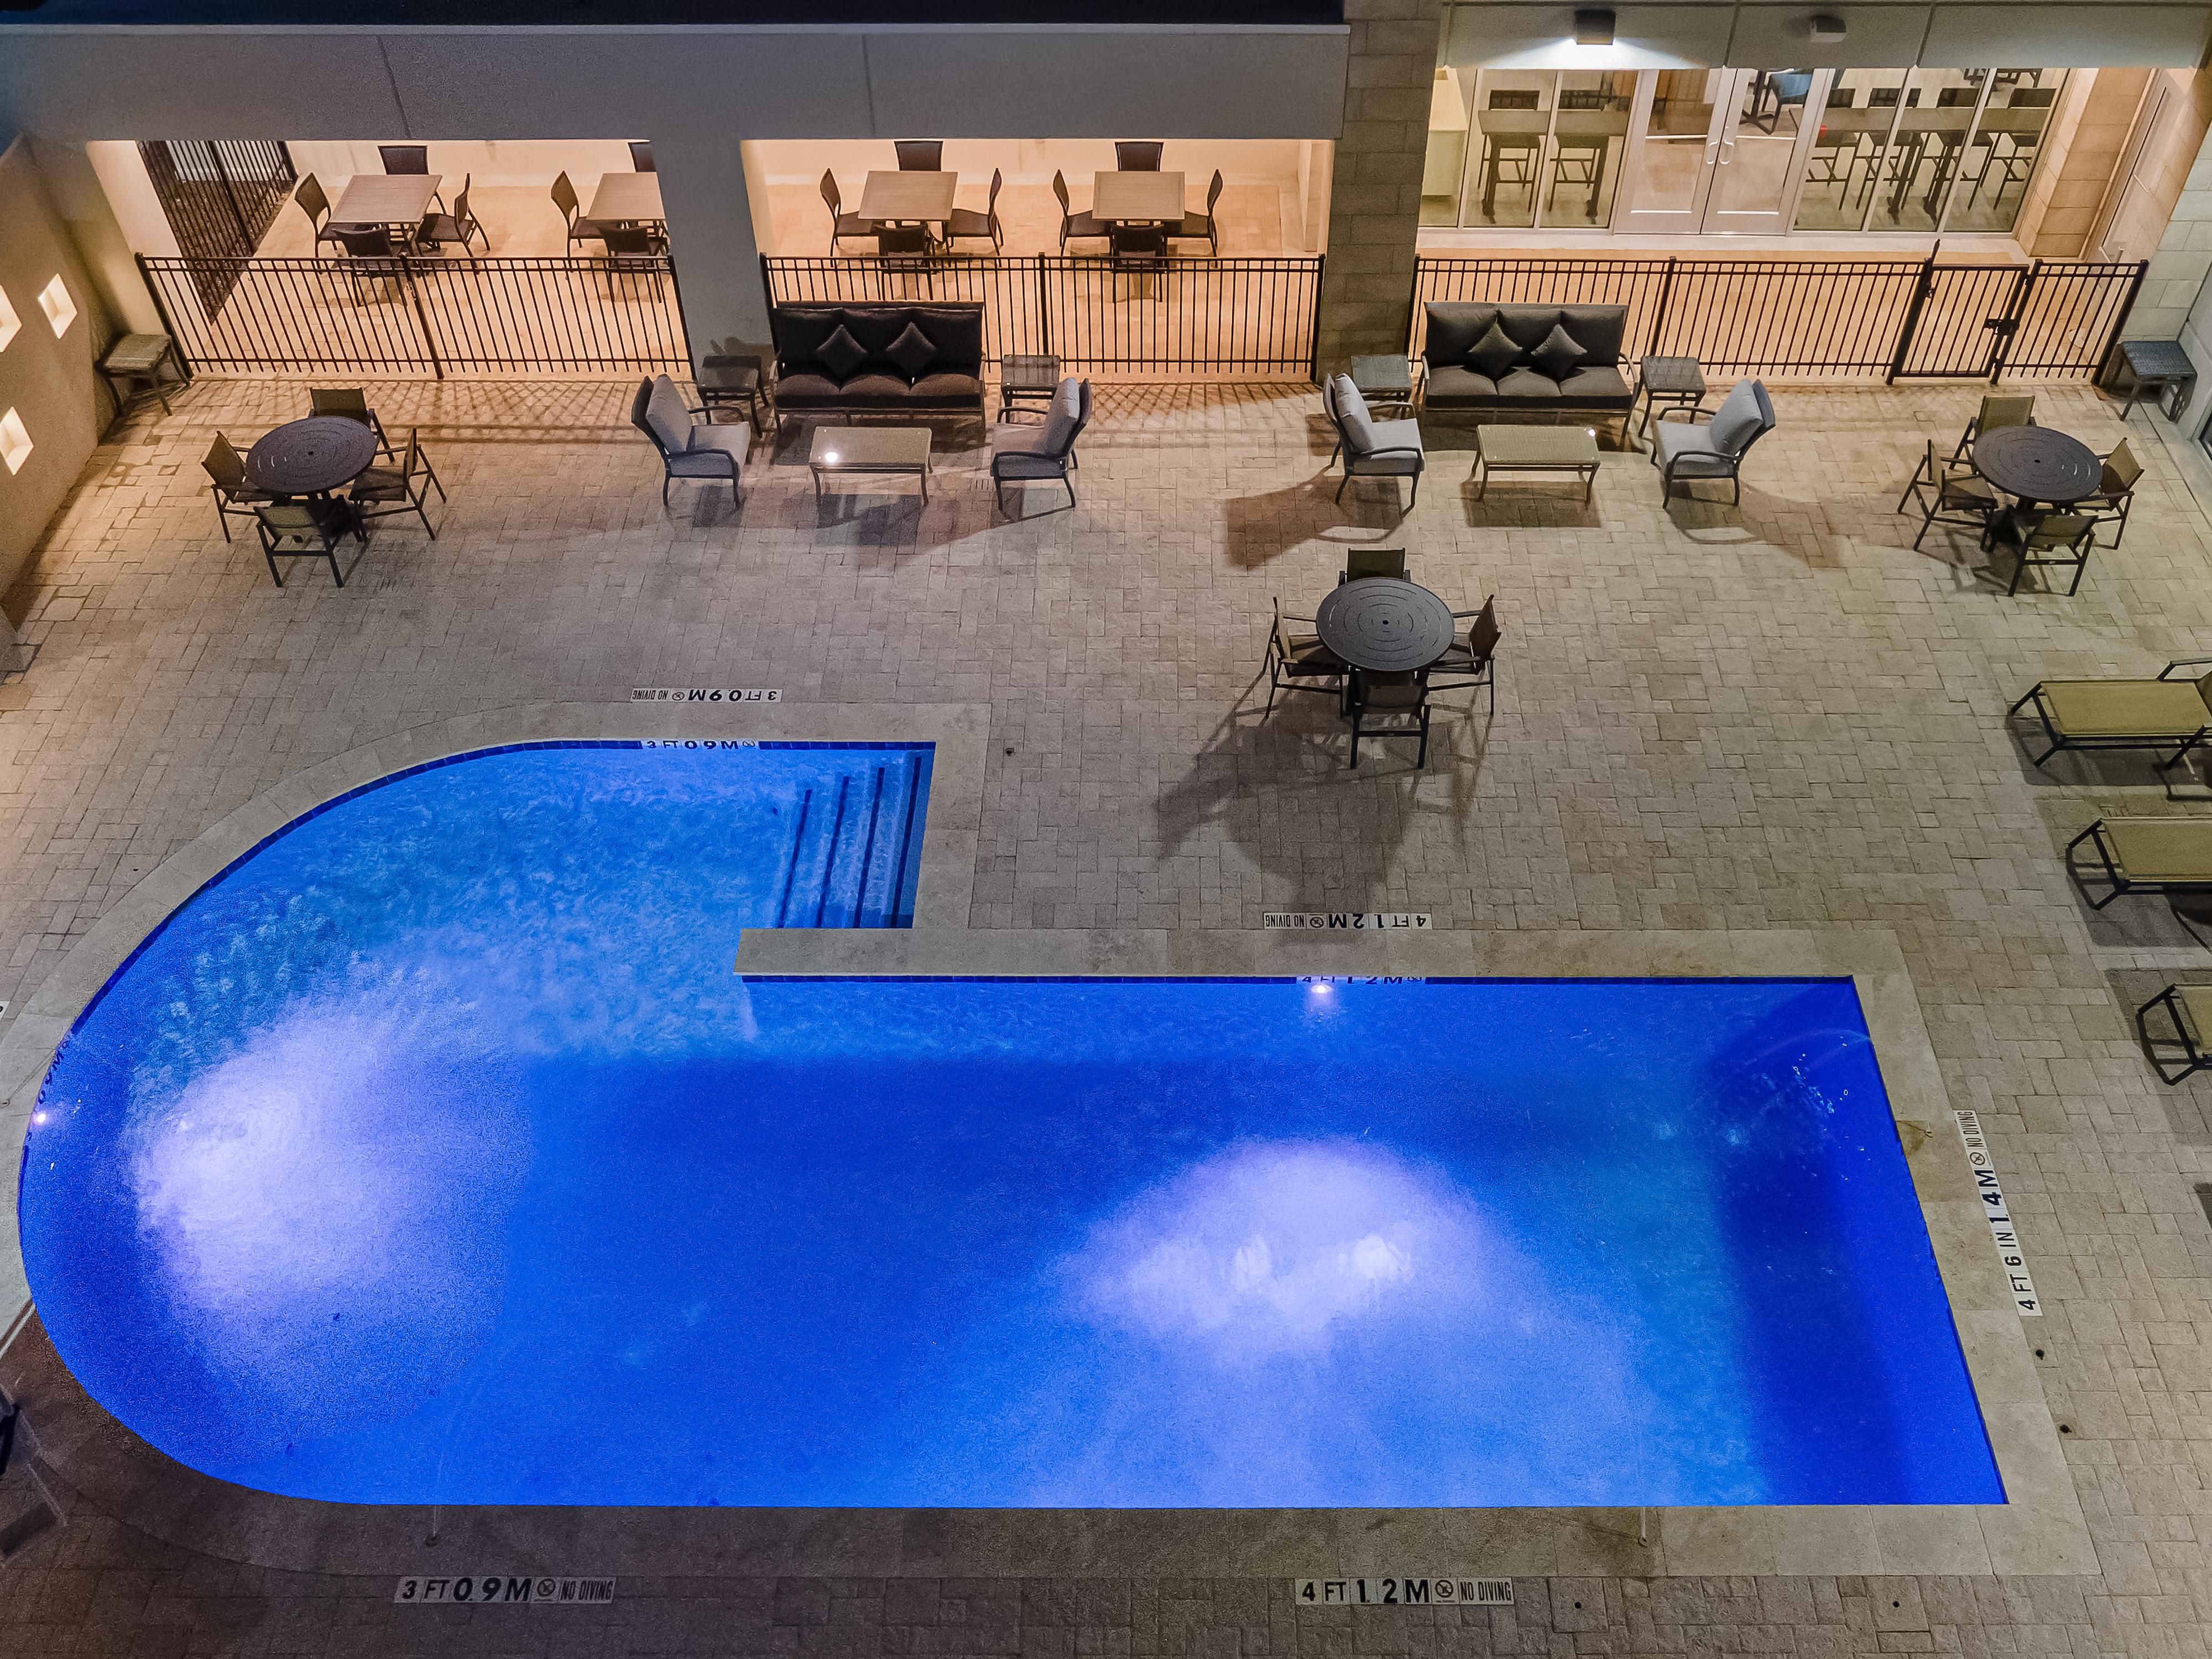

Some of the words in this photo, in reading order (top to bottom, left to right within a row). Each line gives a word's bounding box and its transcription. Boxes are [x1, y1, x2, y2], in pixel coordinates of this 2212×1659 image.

[632, 690, 655, 700] DIVING
[658, 690, 669, 700] NO
[745, 691, 762, 701] FT
[768, 691, 777, 701] 3
[1265, 914, 1291, 927] DIVING
[1293, 914, 1305, 927] NO
[1391, 915, 1409, 927] FT
[1416, 915, 1427, 927] 4
[1957, 1111, 1979, 1135] DIVING
[1966, 1136, 1984, 1147] NO
[1995, 1232, 2017, 1248] IN
[2005, 1255, 2022, 1267] 6
[2010, 1274, 2032, 1292] FT
[2018, 1299, 2036, 1311] 4
[401, 1579, 418, 1600] 3
[424, 1579, 451, 1599] FT
[560, 1580, 577, 1600] NO
[578, 1580, 614, 1601] DIVING
[1302, 1582, 1316, 1602] 4
[1324, 1581, 1347, 1601] FT
[1460, 1581, 1474, 1601] NO
[1478, 1581, 1511, 1602] DIVING
